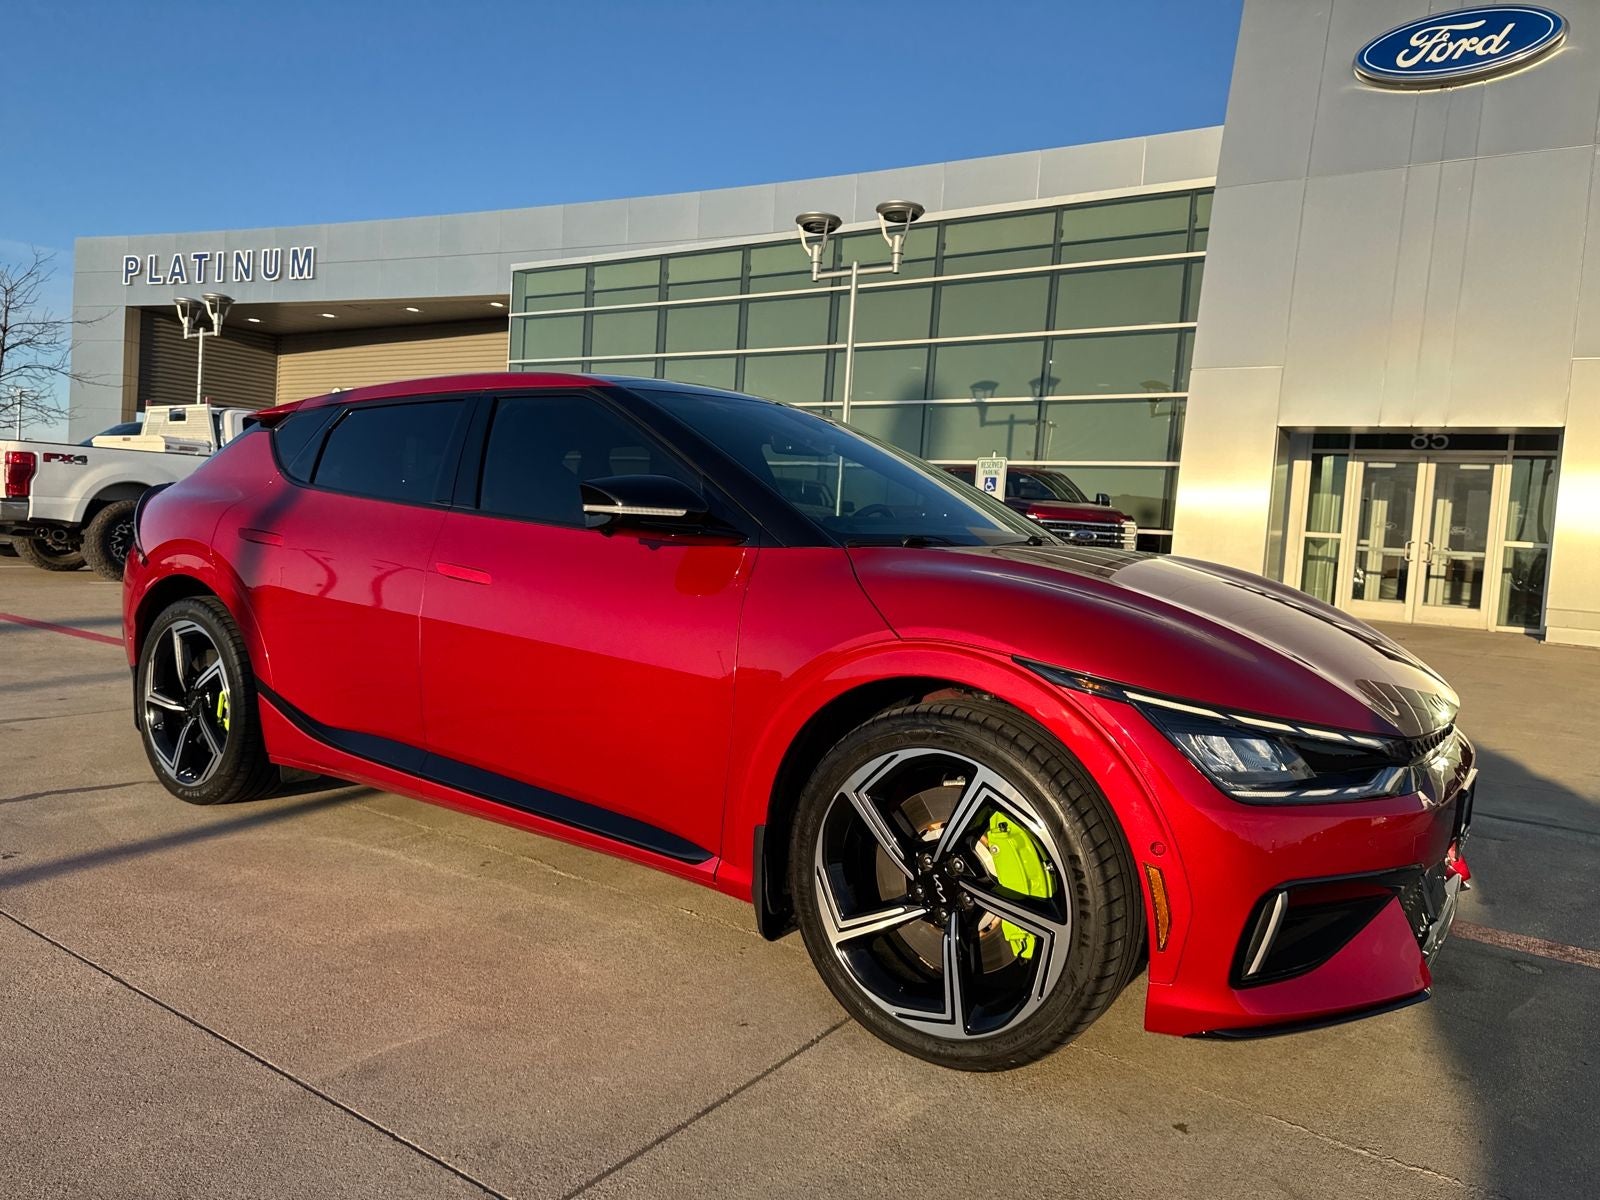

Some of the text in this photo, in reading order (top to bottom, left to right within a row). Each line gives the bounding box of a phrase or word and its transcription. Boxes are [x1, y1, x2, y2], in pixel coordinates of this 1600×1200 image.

[1395, 19, 1516, 68] Ford
[122, 246, 315, 286] PLATINUM
[1411, 433, 1449, 450] 85
[43, 453, 88, 464] FX4
[981, 460, 1004, 468] RESERVED
[1068, 855, 1090, 920] EAGLE
